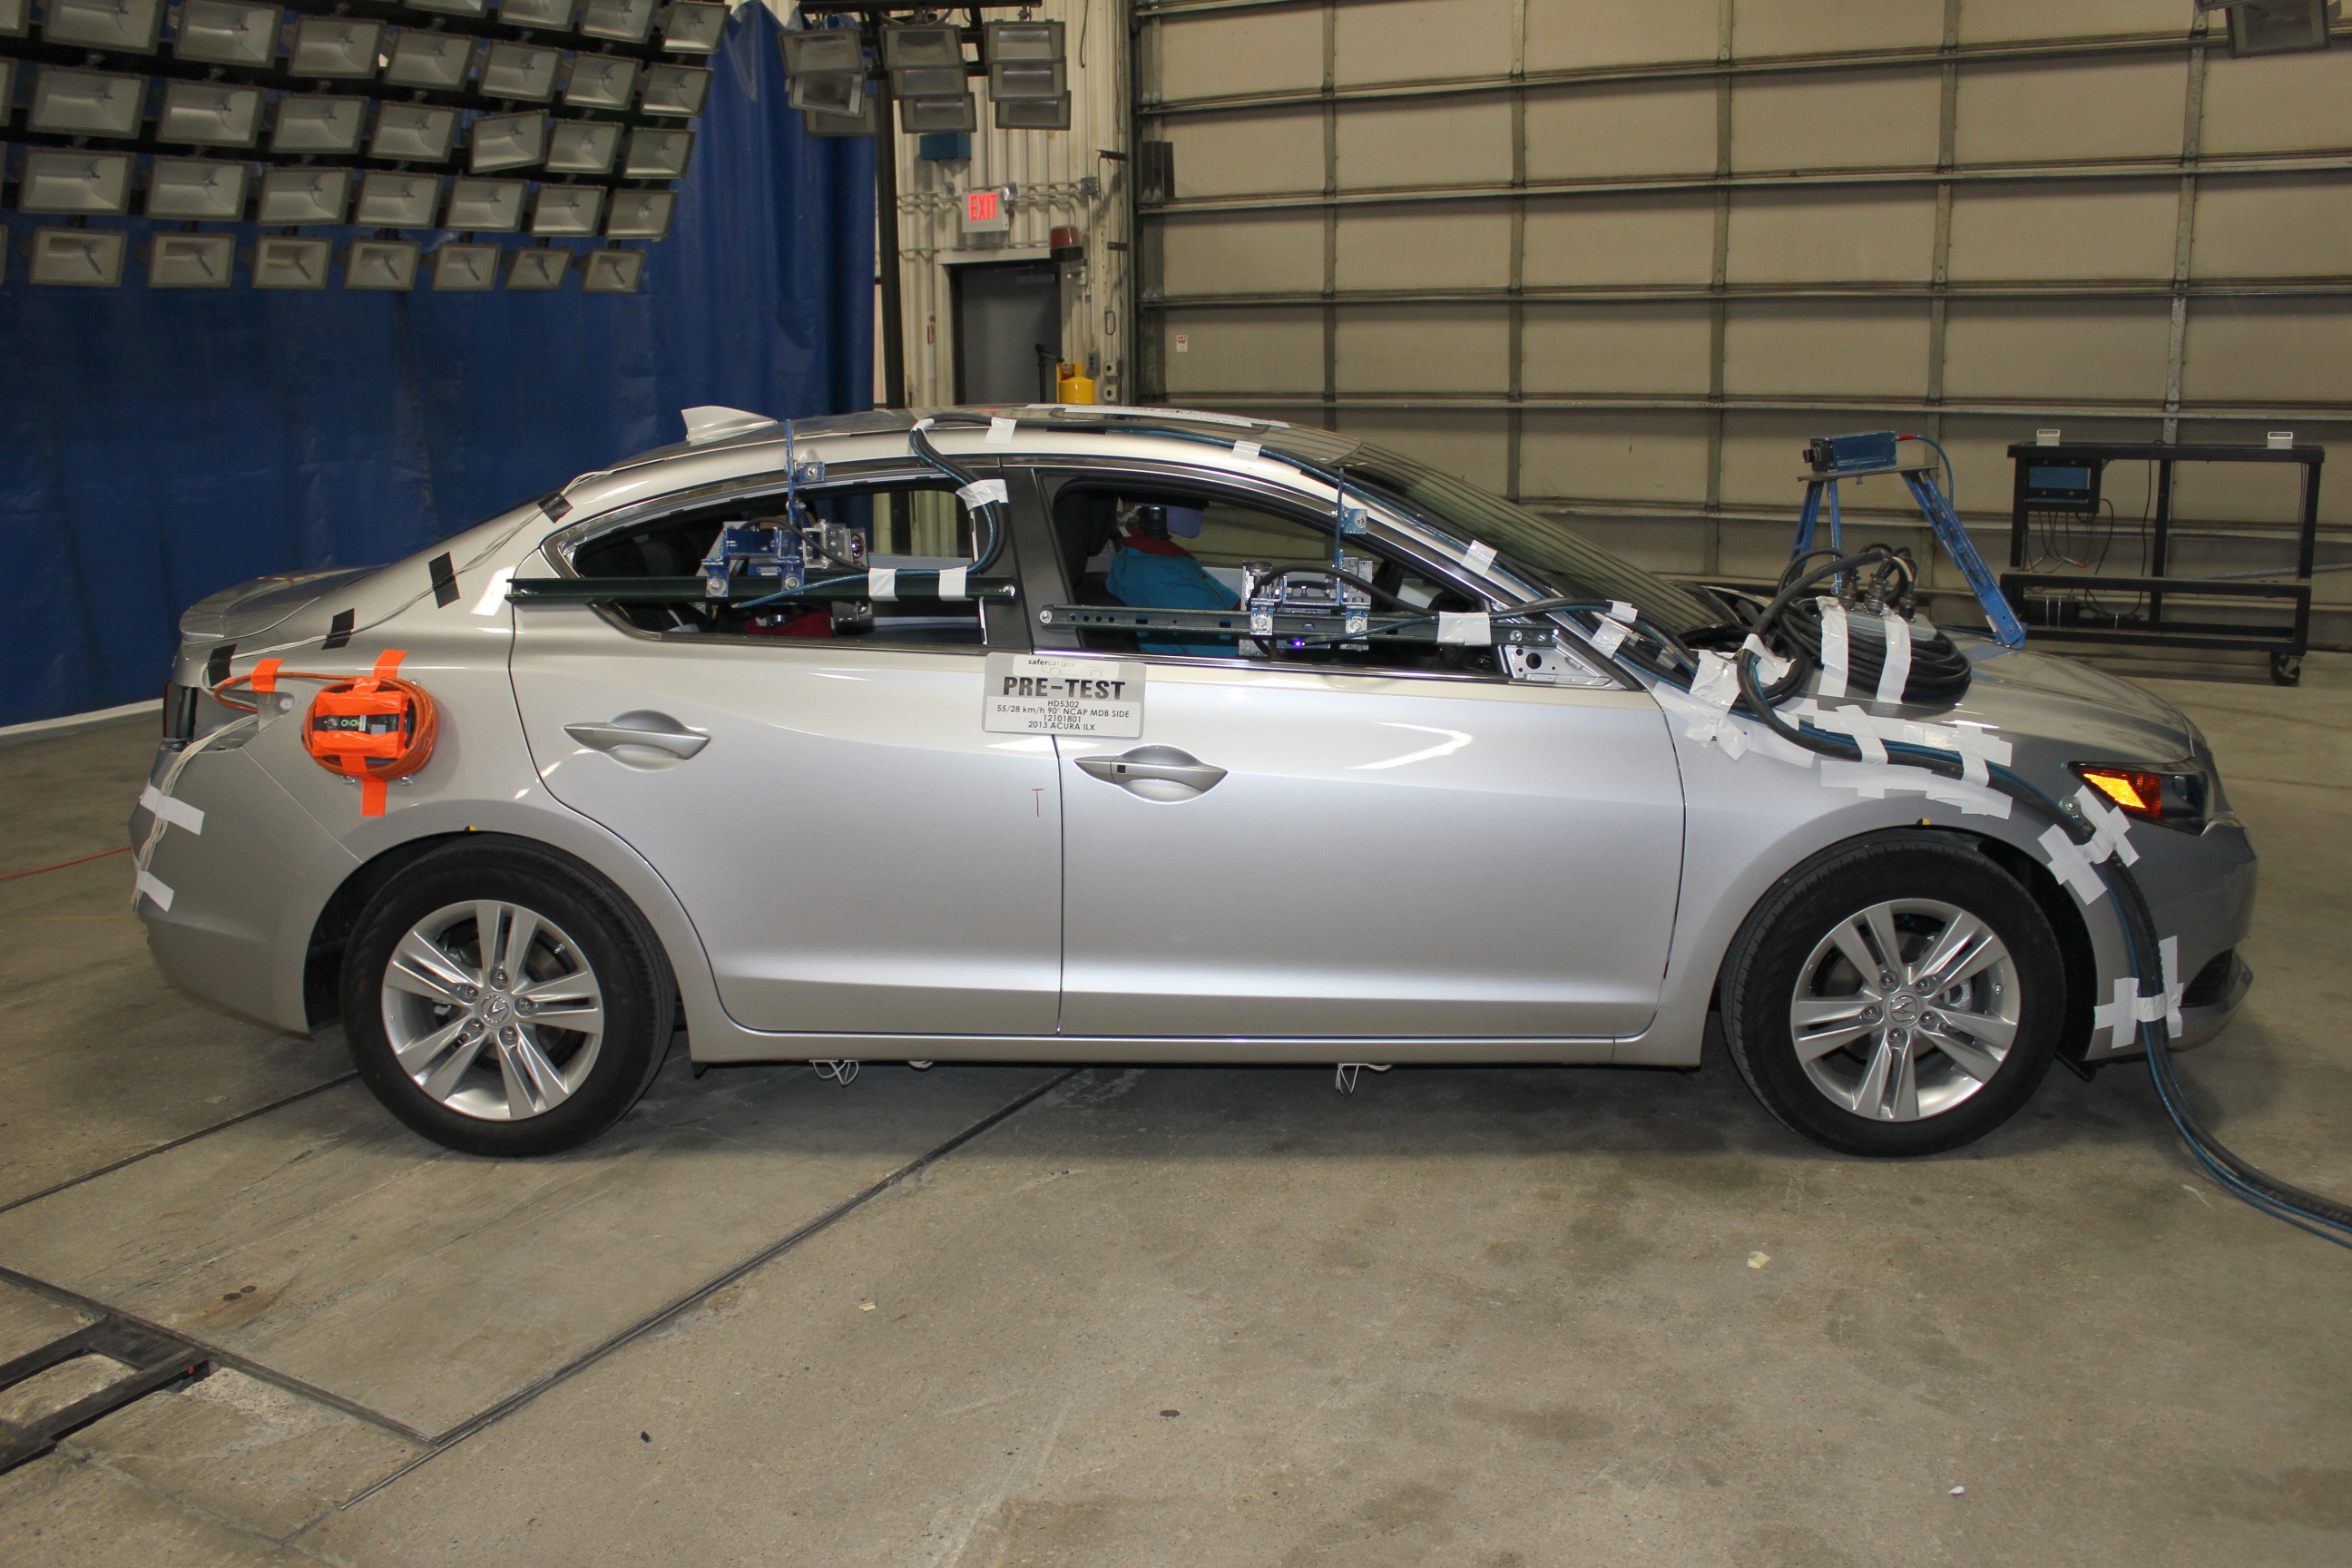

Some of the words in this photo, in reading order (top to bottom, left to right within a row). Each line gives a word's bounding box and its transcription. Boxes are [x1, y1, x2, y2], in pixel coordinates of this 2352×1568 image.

[968, 193, 997, 220] EXIT
[1027, 658, 1077, 669] safercar.gov
[1003, 676, 1126, 700] PRE-TEST
[1047, 700, 1080, 709] HD5302
[996, 704, 1021, 713] 55/28
[1023, 706, 1045, 714] km/h
[1047, 707, 1062, 715] 90°
[1063, 708, 1088, 717] NCAP
[1043, 714, 1082, 723] 12101801
[1028, 720, 1048, 730] 2013
[1050, 722, 1081, 730] ACURA
